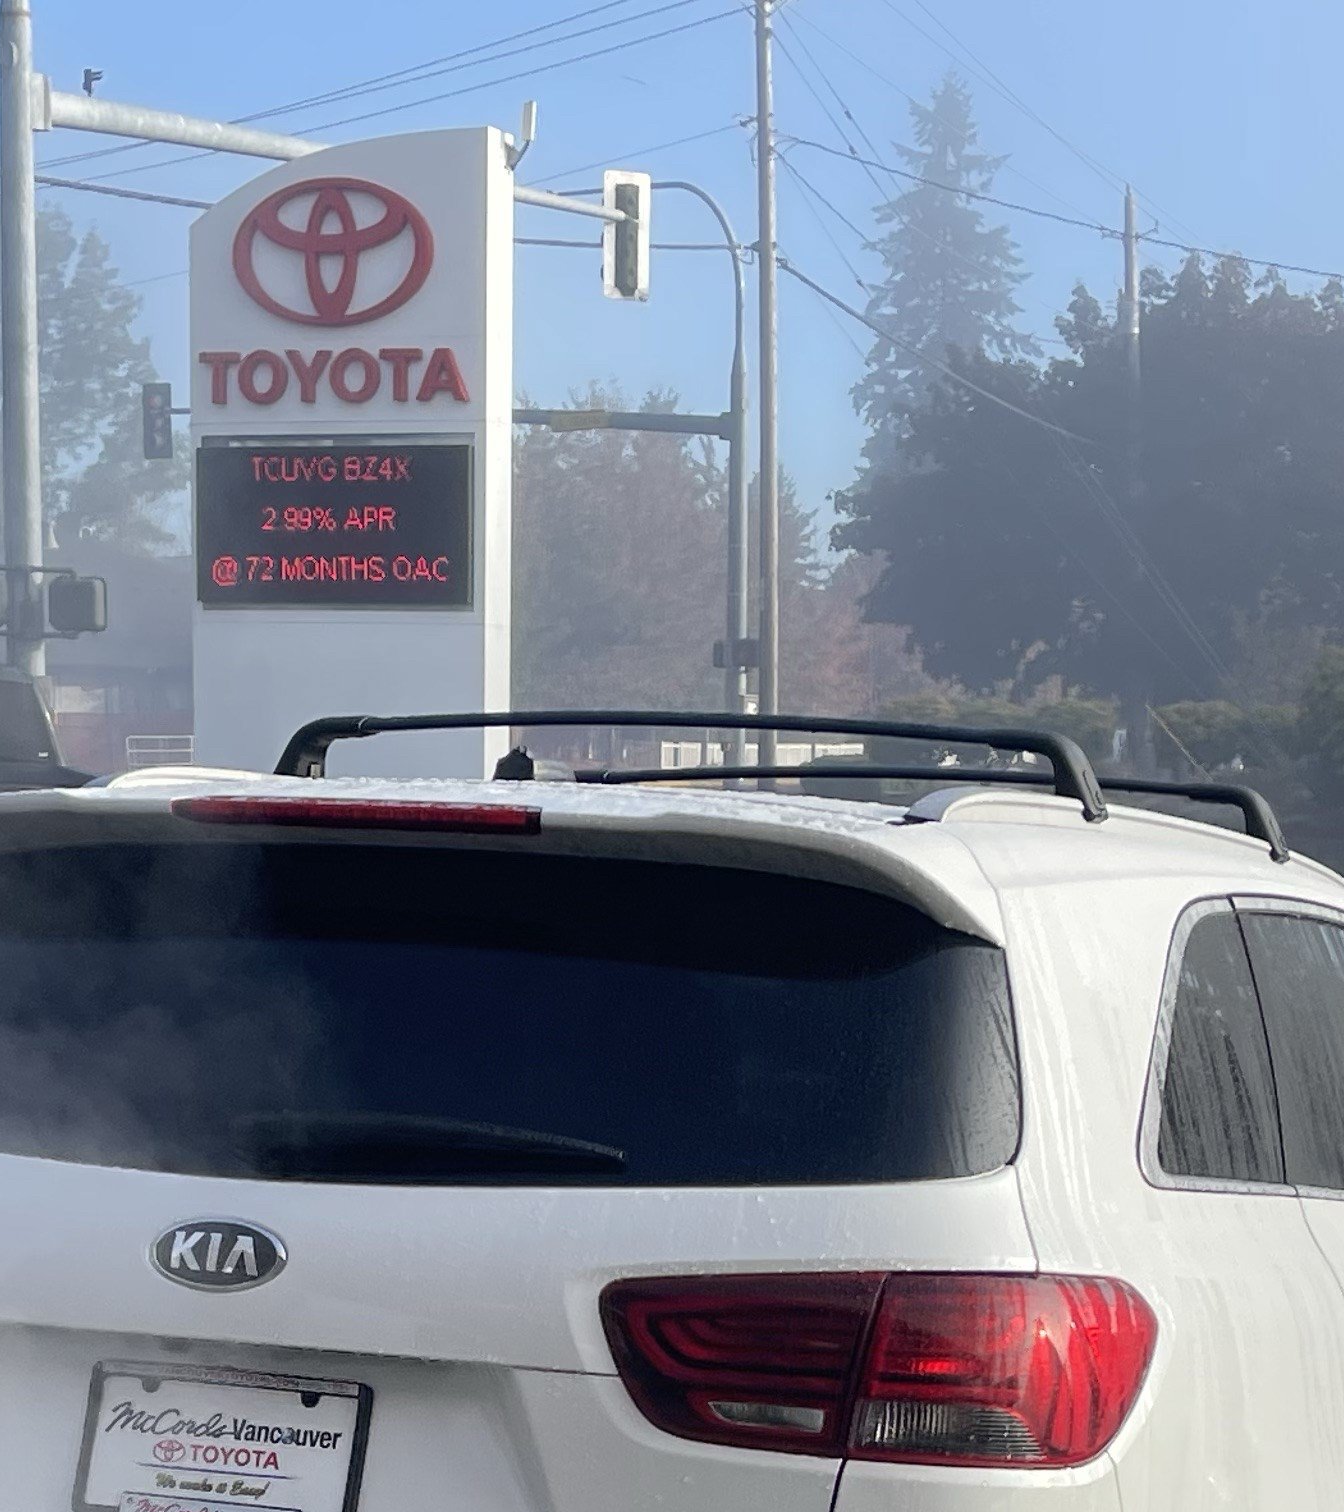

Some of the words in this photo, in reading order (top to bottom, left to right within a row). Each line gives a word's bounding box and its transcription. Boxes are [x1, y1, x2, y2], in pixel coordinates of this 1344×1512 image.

[199, 347, 471, 405] TOYOTA
[343, 455, 413, 482] BZ4X
[342, 506, 397, 532] APR
[245, 555, 275, 582] 72
[280, 555, 386, 582] MONTHS
[392, 555, 449, 582] OAC
[169, 1230, 259, 1277] KIA
[189, 1443, 280, 1471] TOYOTA
